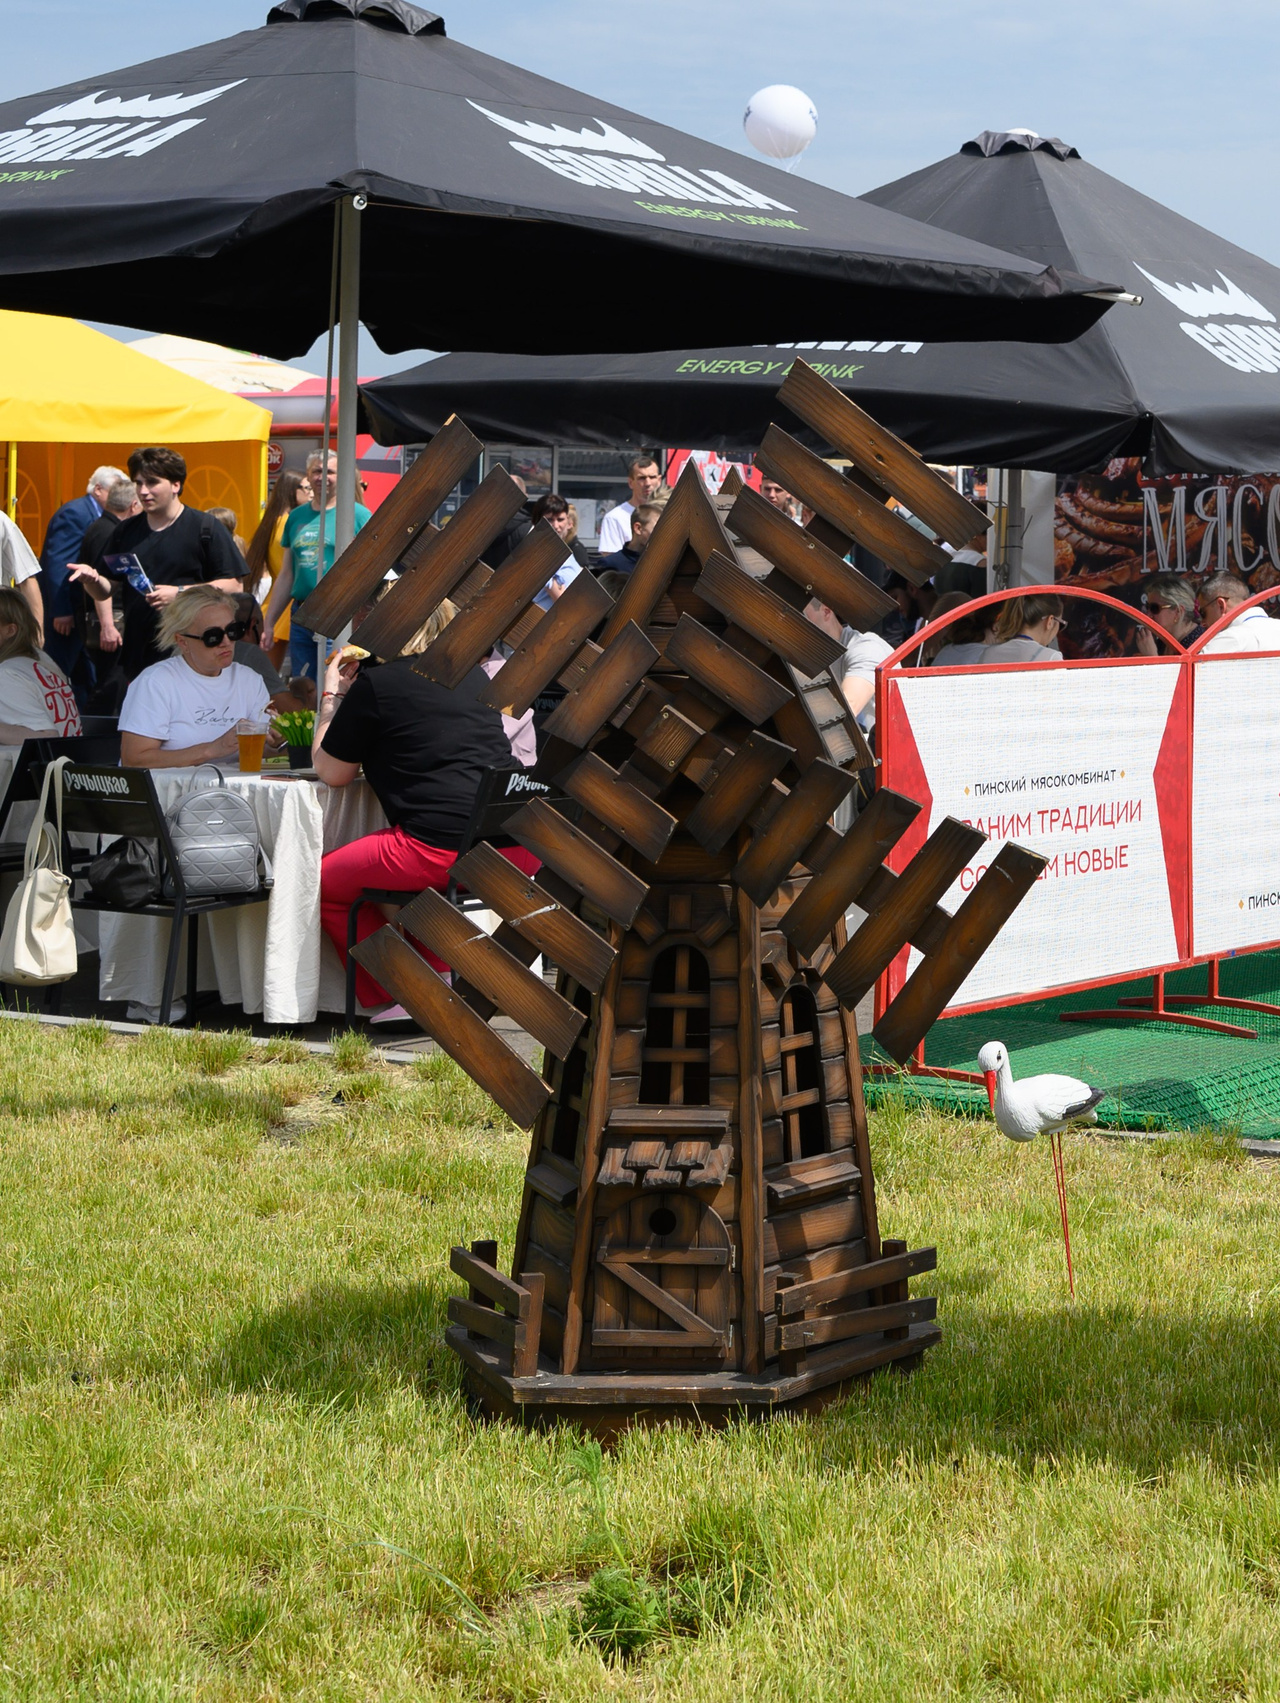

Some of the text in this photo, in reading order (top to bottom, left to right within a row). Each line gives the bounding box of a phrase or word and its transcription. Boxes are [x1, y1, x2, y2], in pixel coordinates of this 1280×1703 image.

[508, 141, 798, 213] GORILLA
[633, 200, 809, 231] ENERGY DRINK
[676, 359, 783, 376] ENERGY
[974, 769, 1117, 797] ПИНСКИЙ МЯСОКОМБИНАТ
[1037, 799, 1142, 834] ТРАДИЦИИ
[1064, 844, 1129, 877] НОВЫЕ
